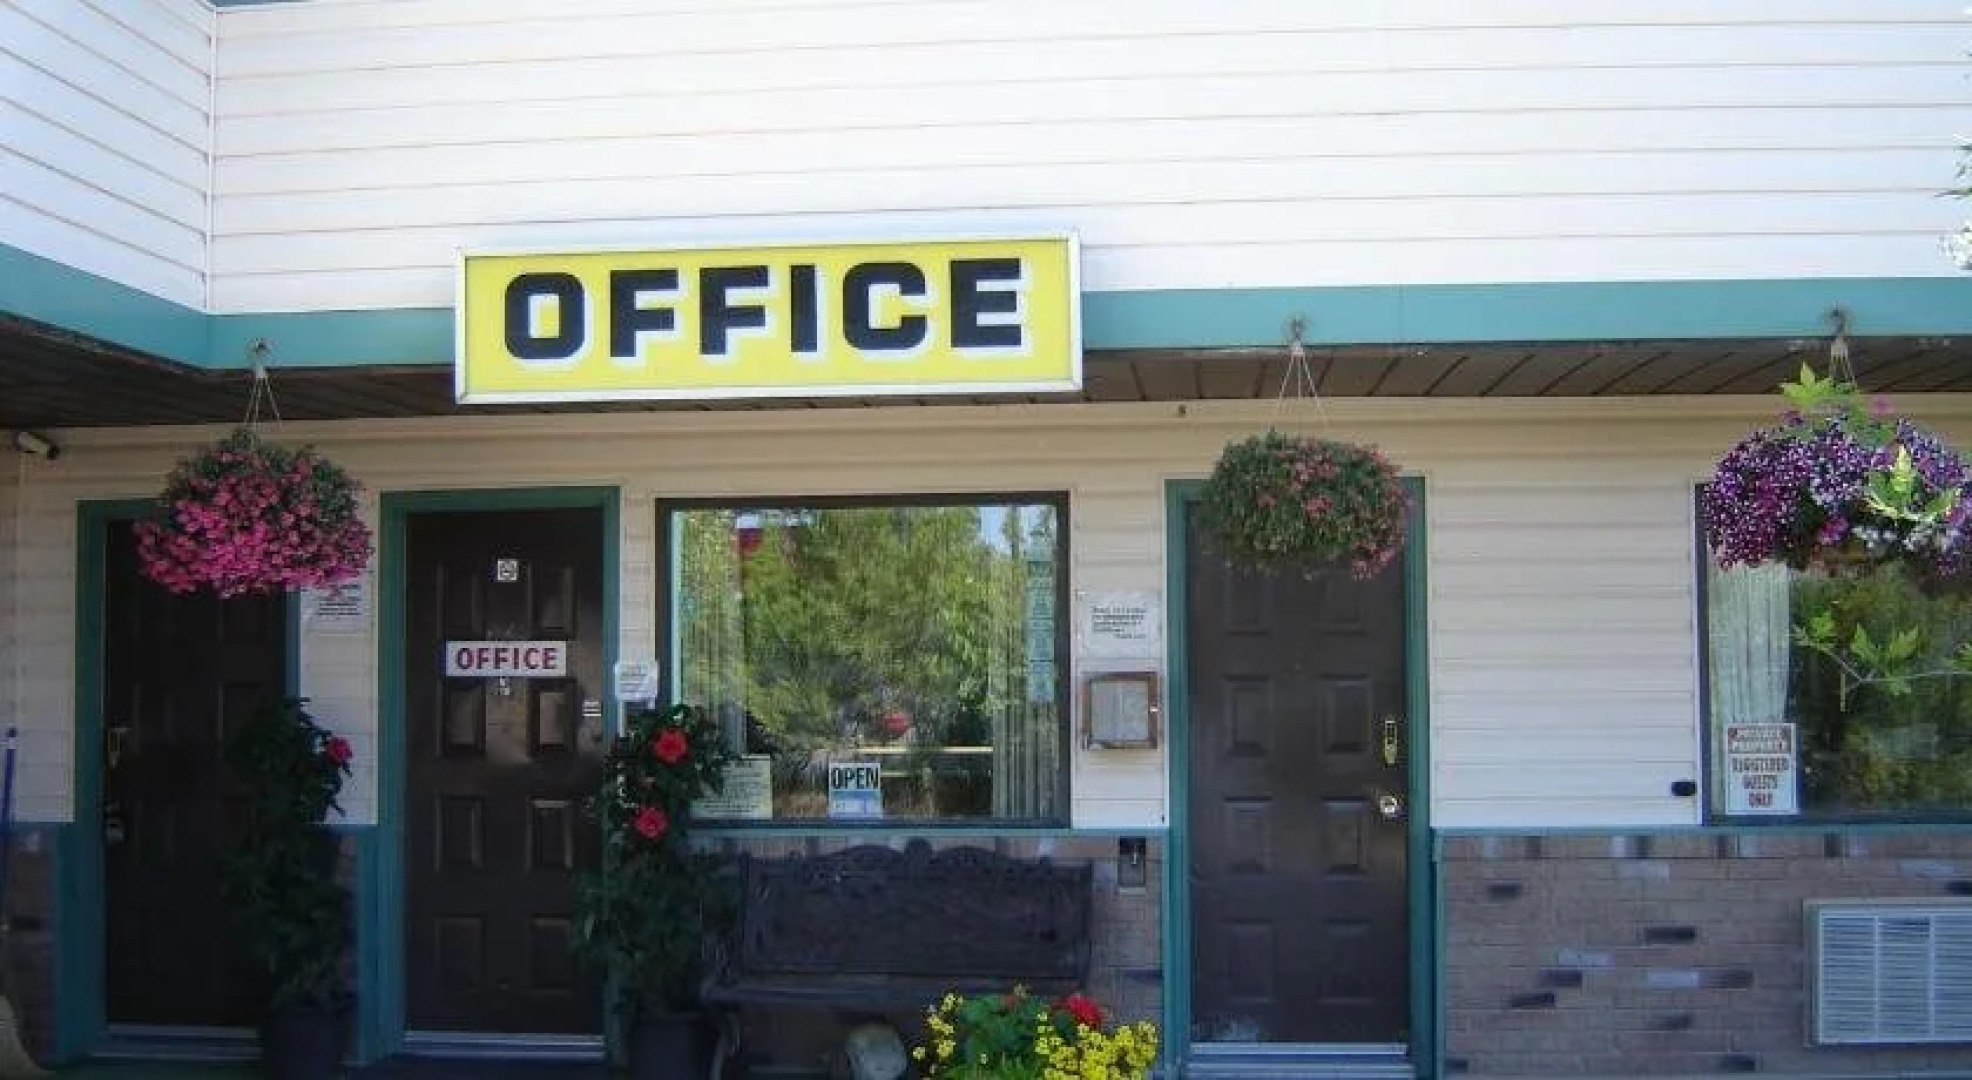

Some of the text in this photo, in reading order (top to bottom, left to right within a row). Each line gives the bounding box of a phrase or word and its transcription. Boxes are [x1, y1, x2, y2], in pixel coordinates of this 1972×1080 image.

[504, 258, 1024, 362] OFFICE
[456, 647, 558, 670] OFFICE
[832, 768, 879, 790] OPEN
